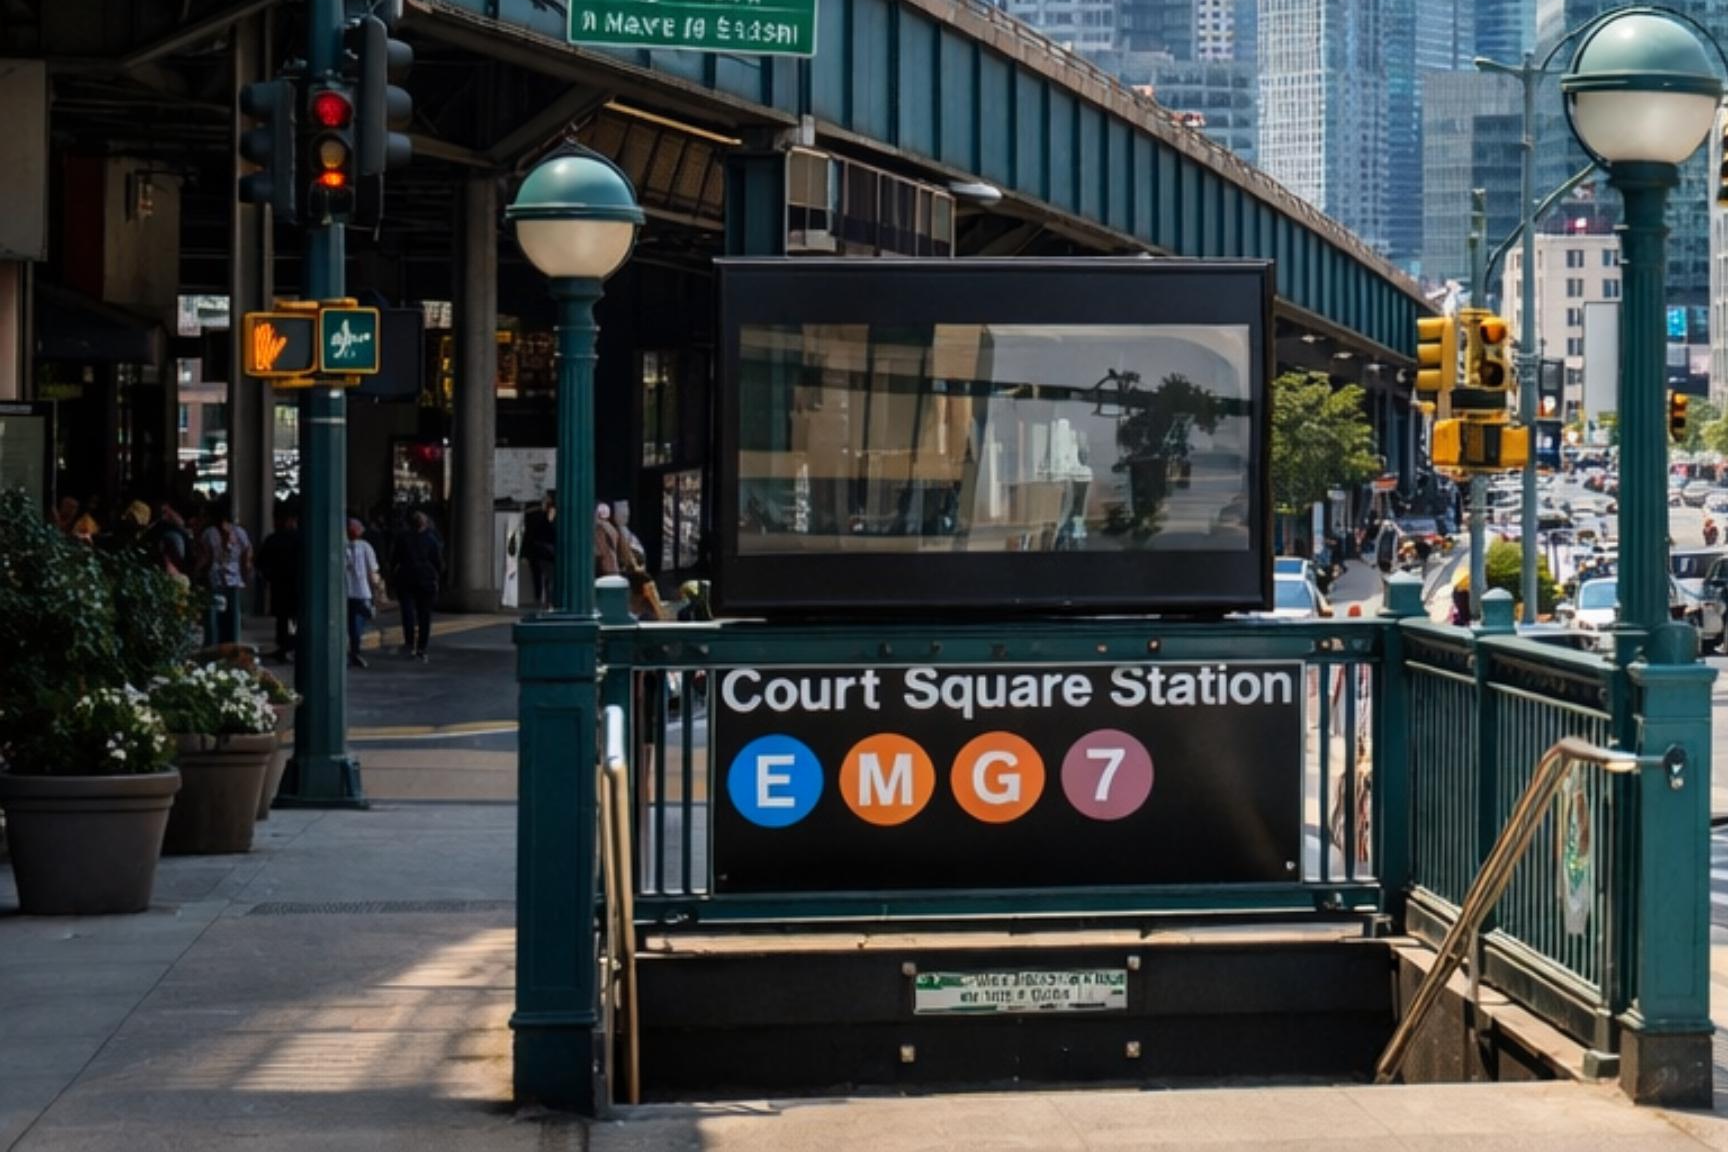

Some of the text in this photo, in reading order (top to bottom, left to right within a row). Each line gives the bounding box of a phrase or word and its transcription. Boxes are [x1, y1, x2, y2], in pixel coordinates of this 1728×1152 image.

[721, 664, 1292, 719] Court Square Station
[756, 748, 1126, 808] E M G 7
